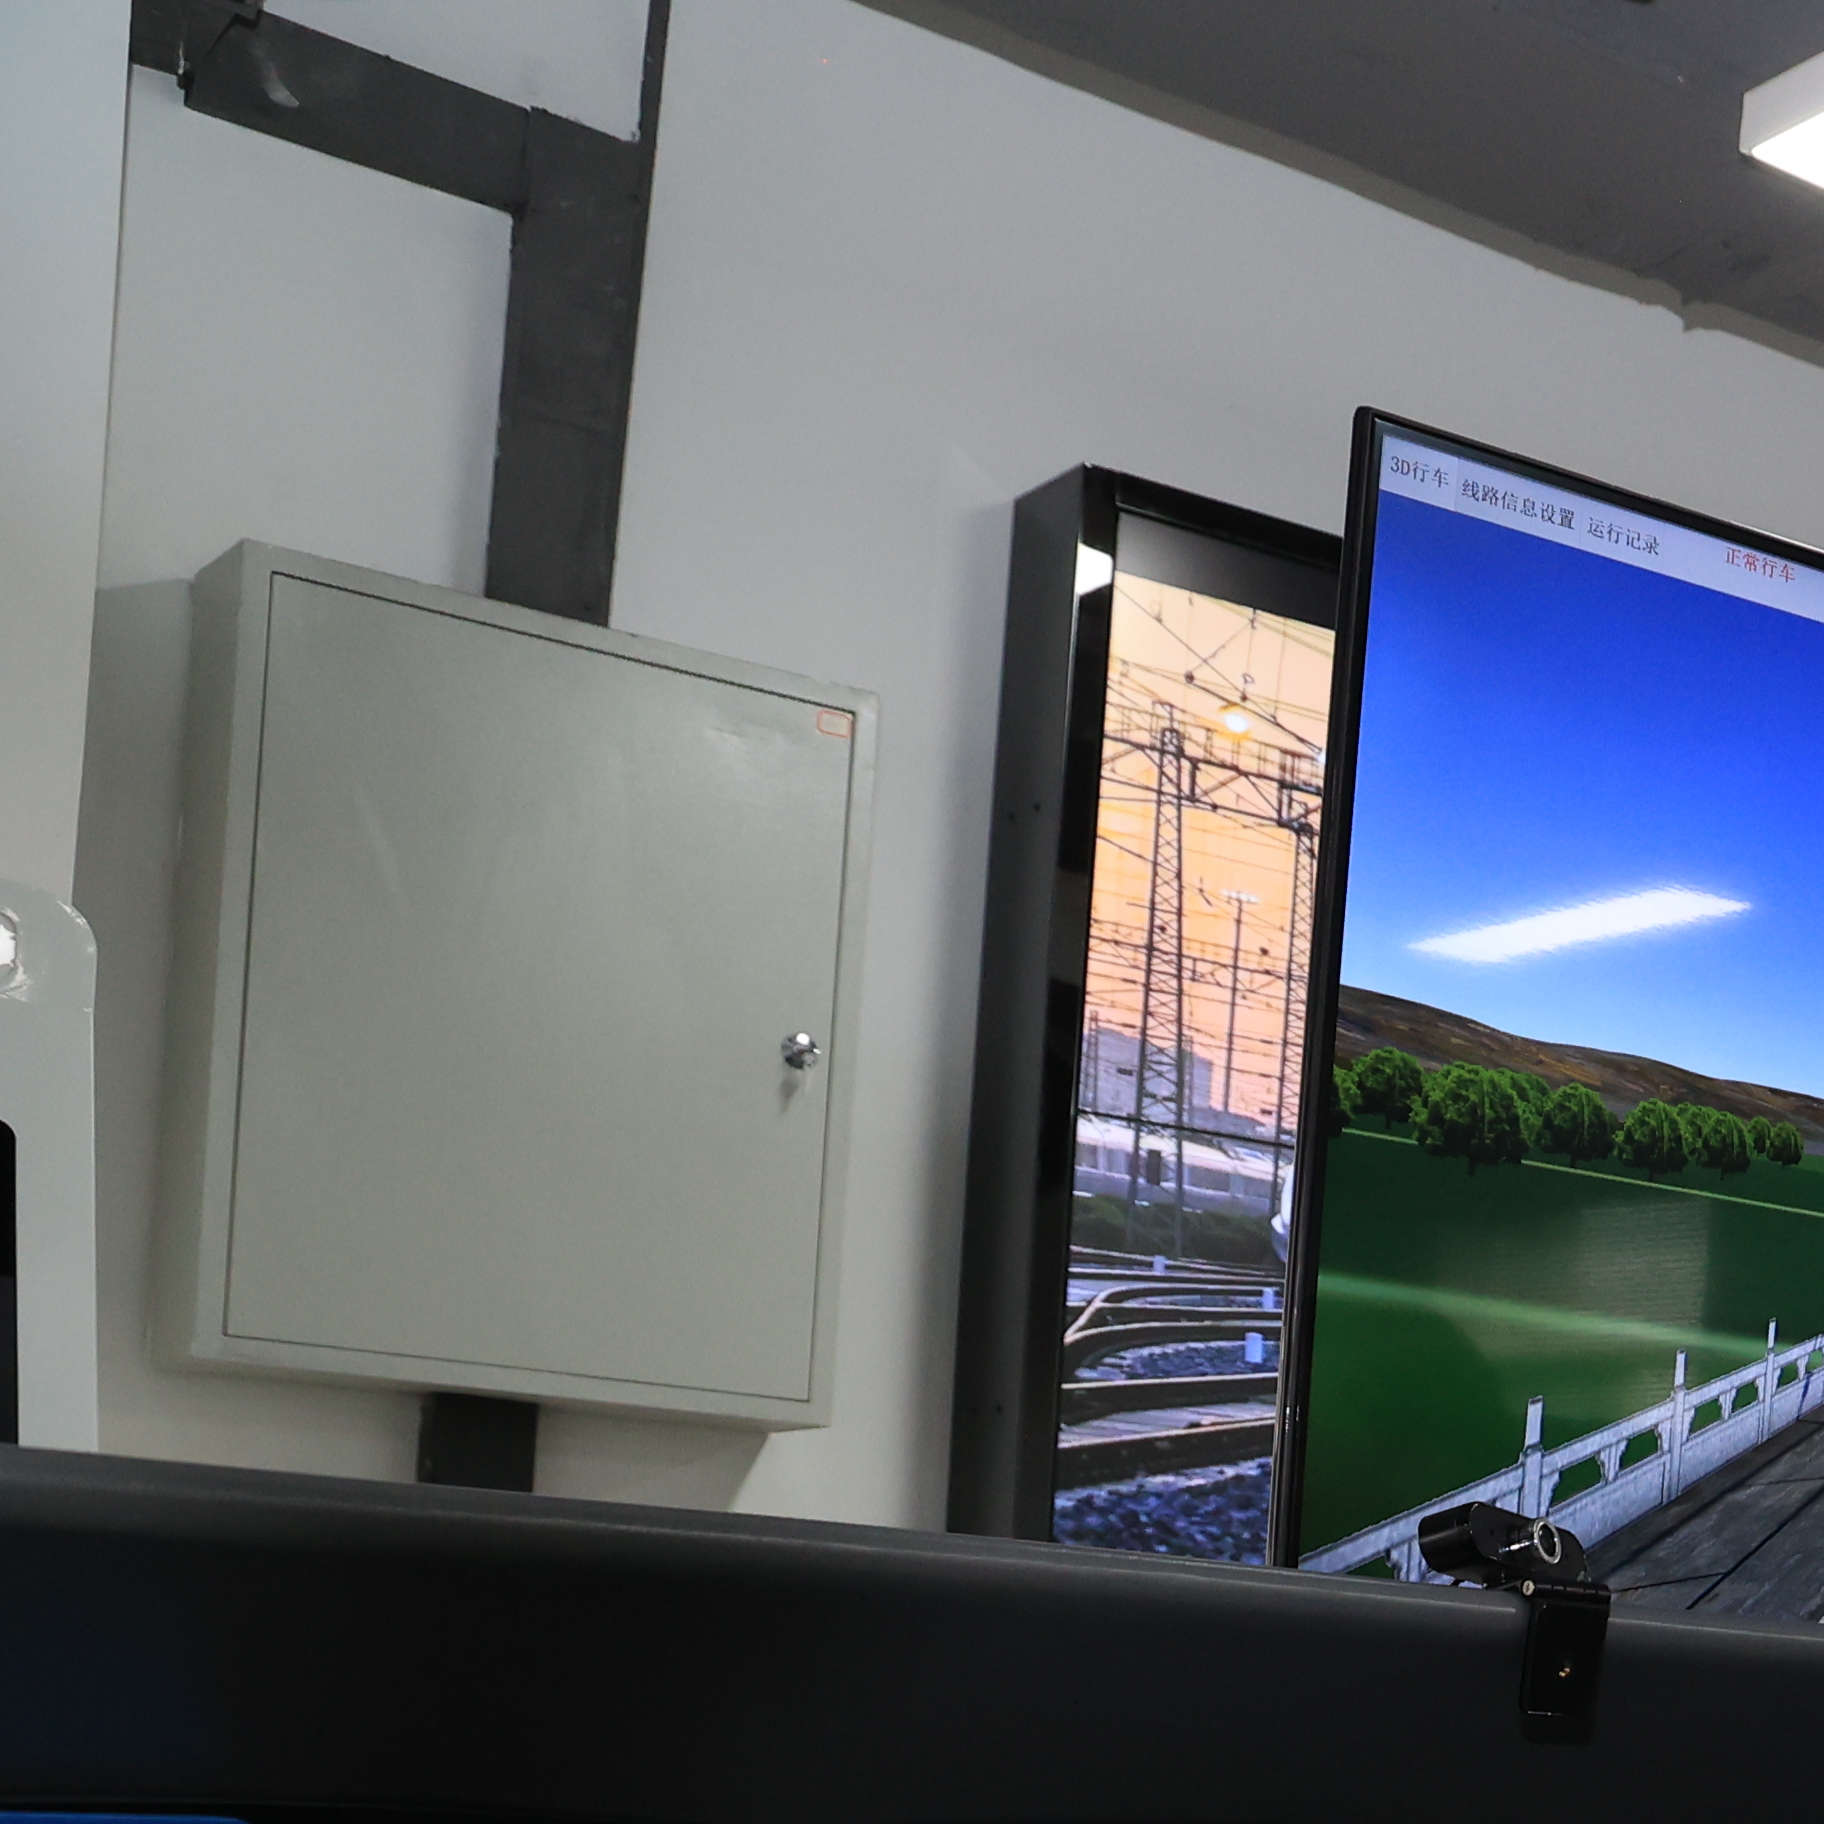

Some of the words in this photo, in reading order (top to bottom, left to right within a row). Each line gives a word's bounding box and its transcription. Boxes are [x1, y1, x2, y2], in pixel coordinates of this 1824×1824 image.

[1389, 454, 1449, 489] 3D行车
[1460, 478, 1576, 531] 线路信息设置
[1586, 515, 1661, 557] 运行记录
[1724, 545, 1797, 584] 正常行车
